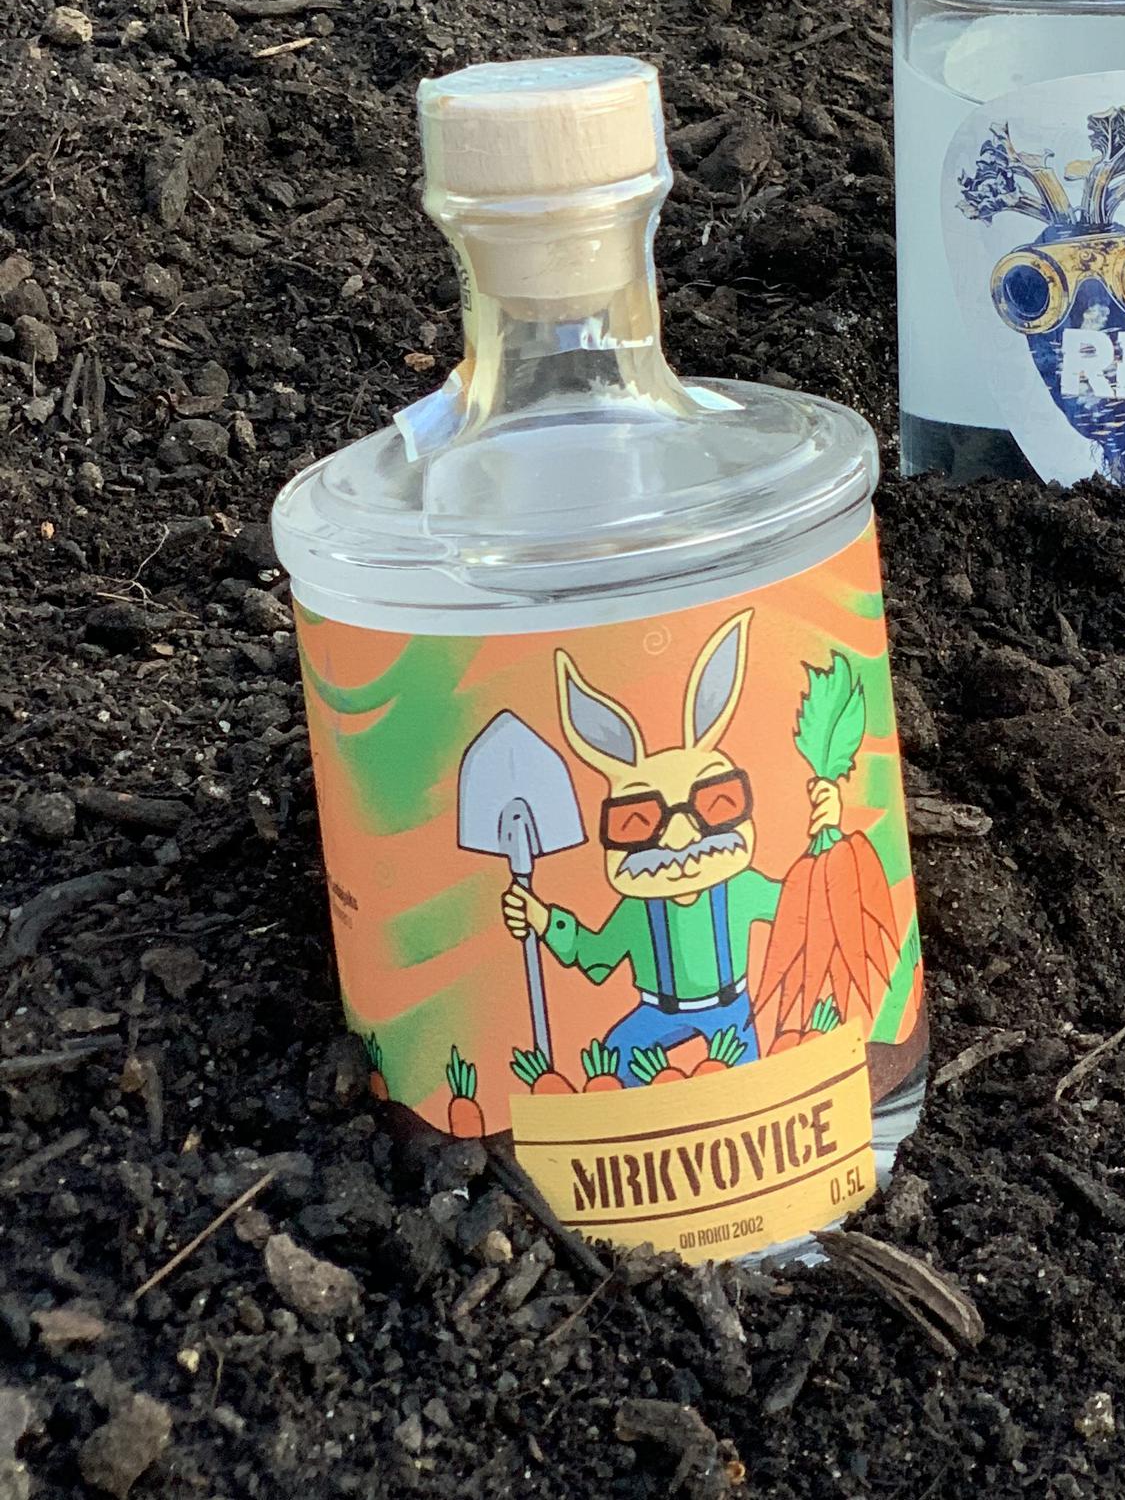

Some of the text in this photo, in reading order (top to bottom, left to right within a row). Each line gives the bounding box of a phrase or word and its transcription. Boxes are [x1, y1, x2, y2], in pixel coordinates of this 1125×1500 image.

[571, 1098, 838, 1211] MRKVOVICE
[830, 1165, 866, 1206] 0.5L
[679, 1215, 764, 1249] OD ROKU 2002
